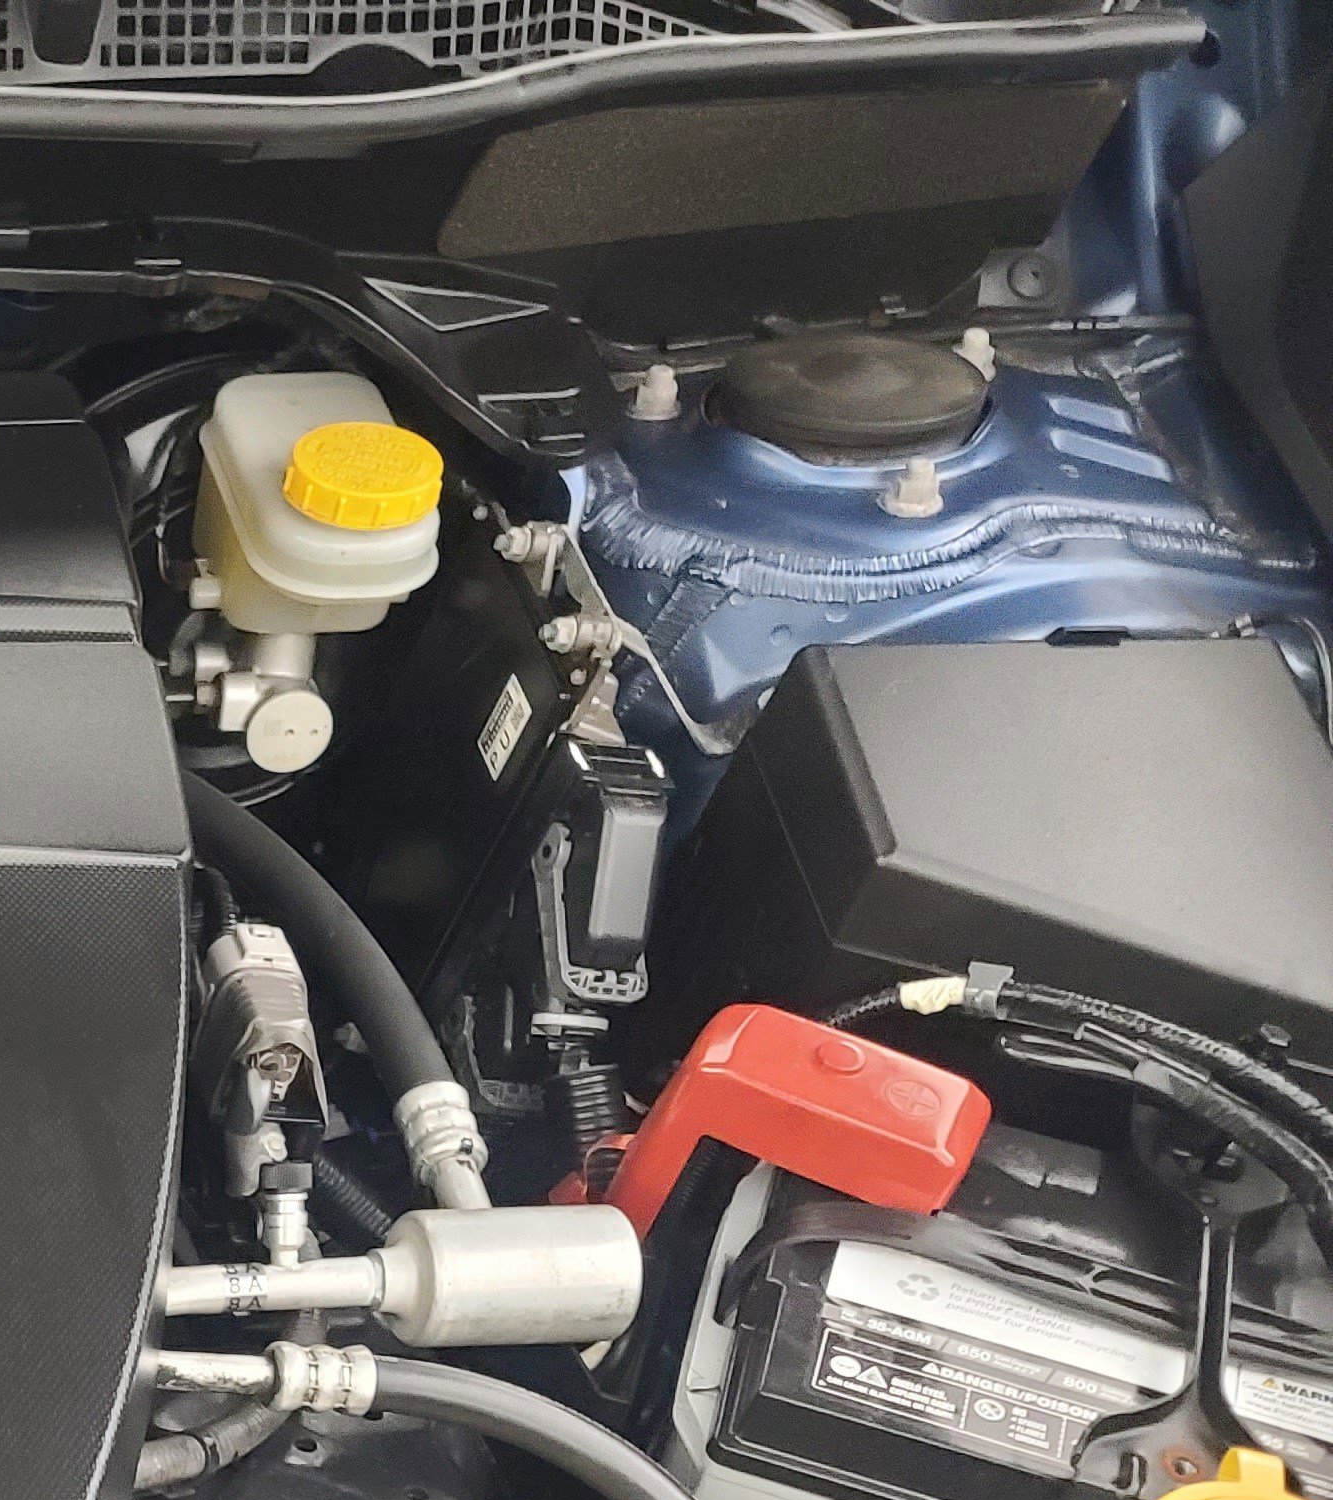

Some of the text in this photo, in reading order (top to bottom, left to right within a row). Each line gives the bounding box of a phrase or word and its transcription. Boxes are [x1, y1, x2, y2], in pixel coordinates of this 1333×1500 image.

[944, 1301, 1002, 1323] provider
[1025, 1324, 1072, 1345] proper
[964, 1296, 1073, 1334] PROFESSIONAL
[957, 1343, 992, 1362] 650
